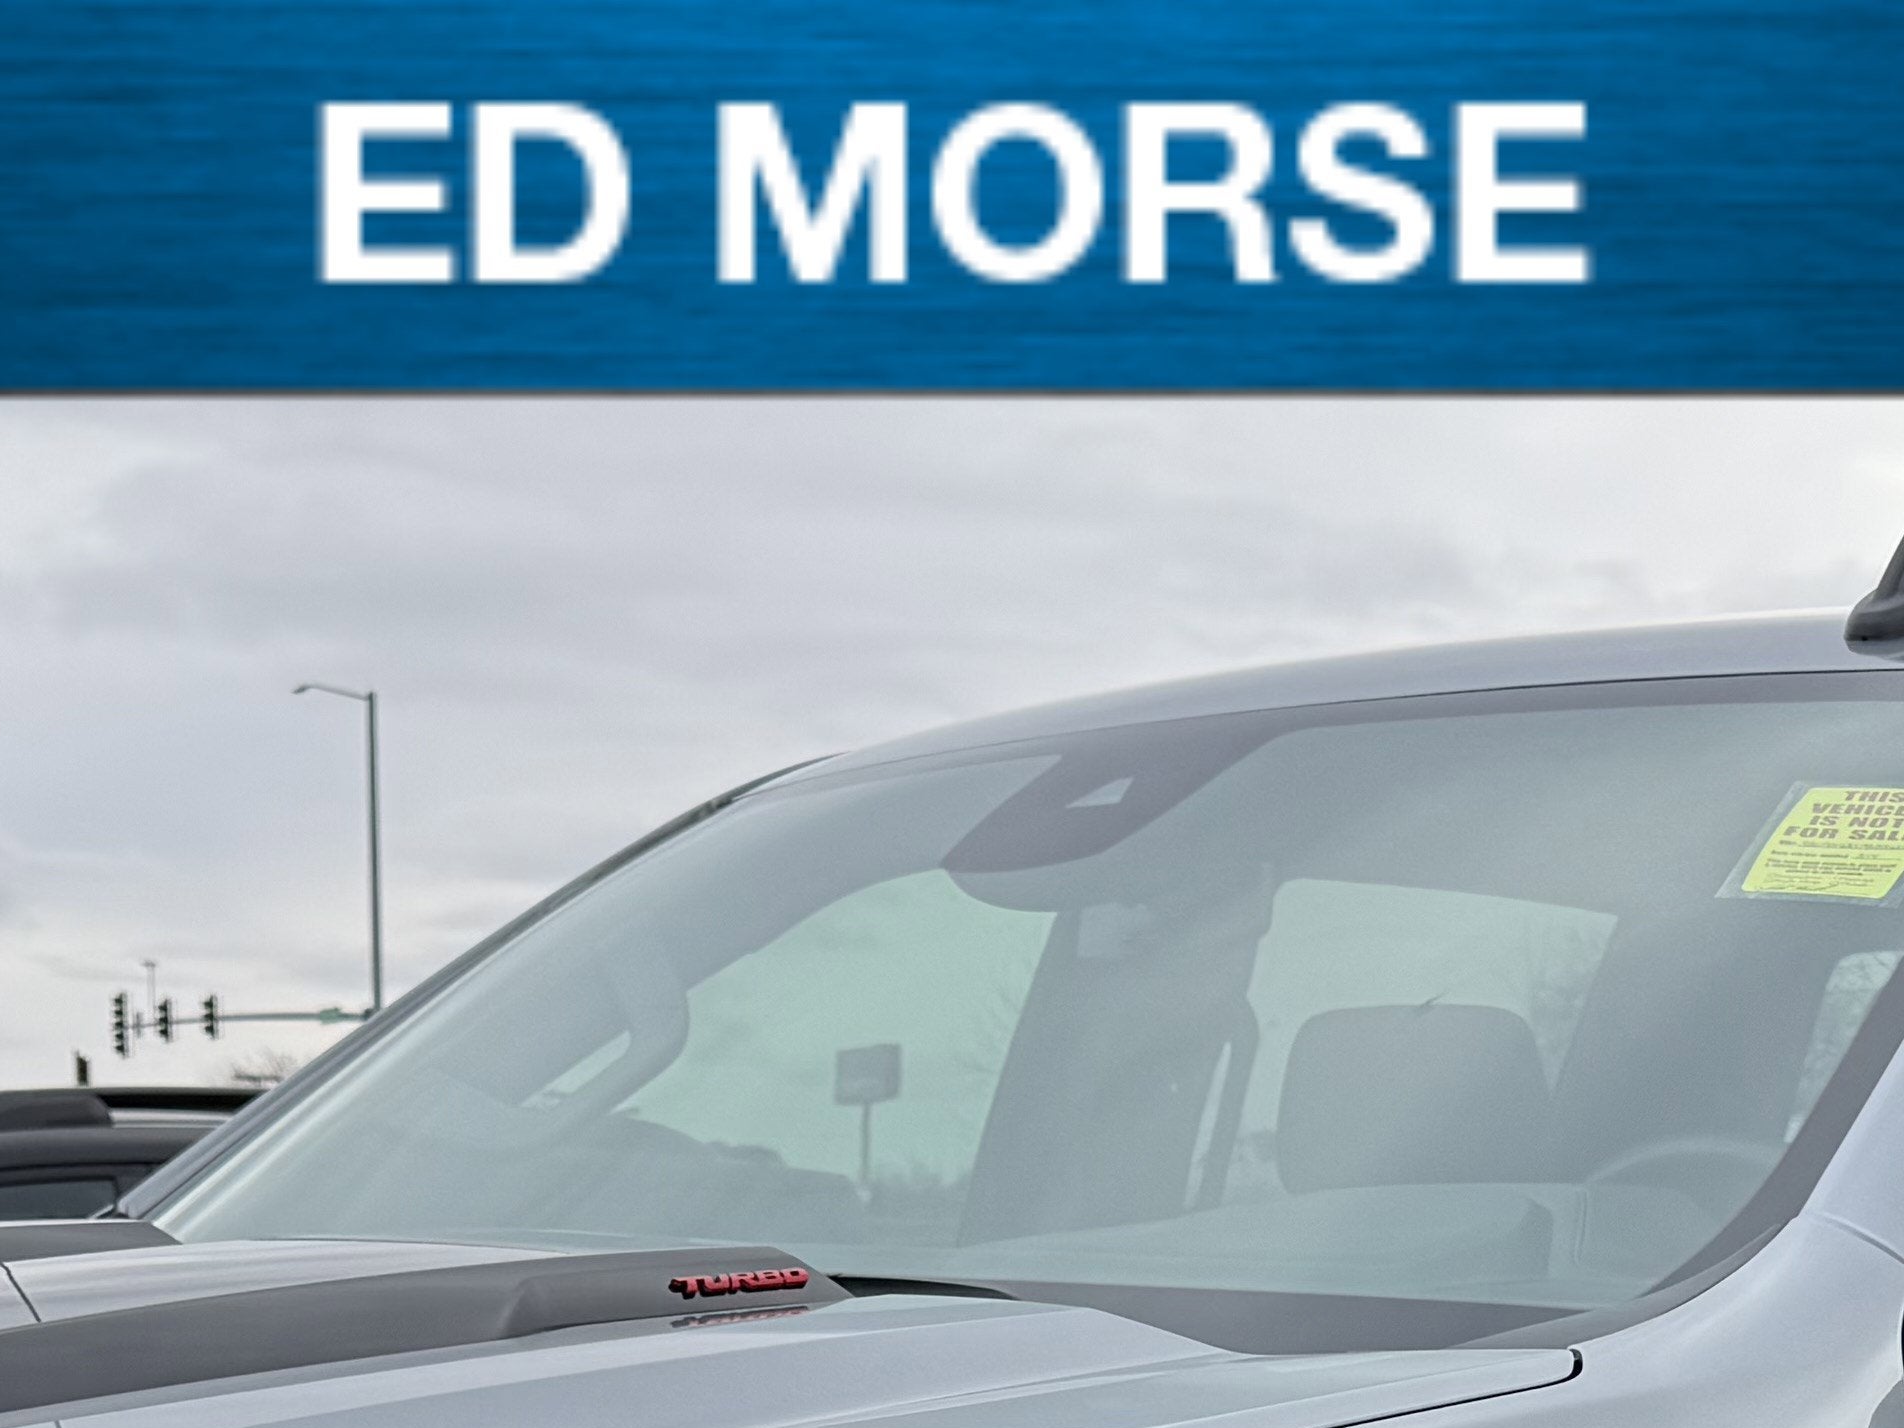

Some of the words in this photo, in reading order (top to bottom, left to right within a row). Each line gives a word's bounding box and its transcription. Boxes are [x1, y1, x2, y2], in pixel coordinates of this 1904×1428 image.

[1809, 815, 1841, 826] IS
[1783, 826, 1840, 839] FOR
[668, 1267, 810, 1300] TURBO
